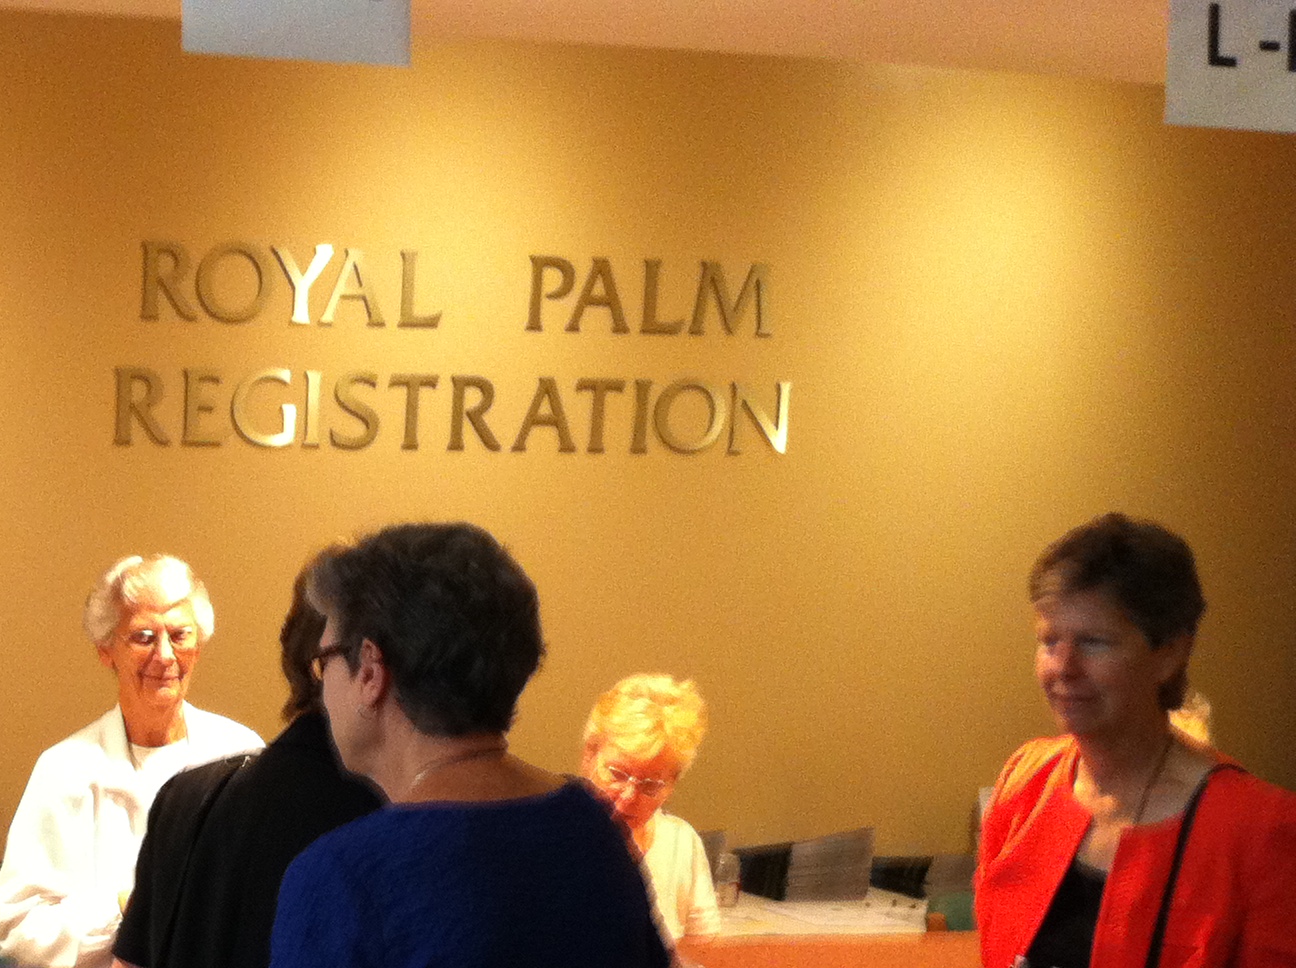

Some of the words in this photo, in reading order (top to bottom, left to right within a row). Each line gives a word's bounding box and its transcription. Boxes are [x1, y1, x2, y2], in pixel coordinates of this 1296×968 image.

[140, 239, 443, 329] ROYAL
[525, 254, 773, 338] PALM
[113, 365, 792, 455] REGISTRATION
